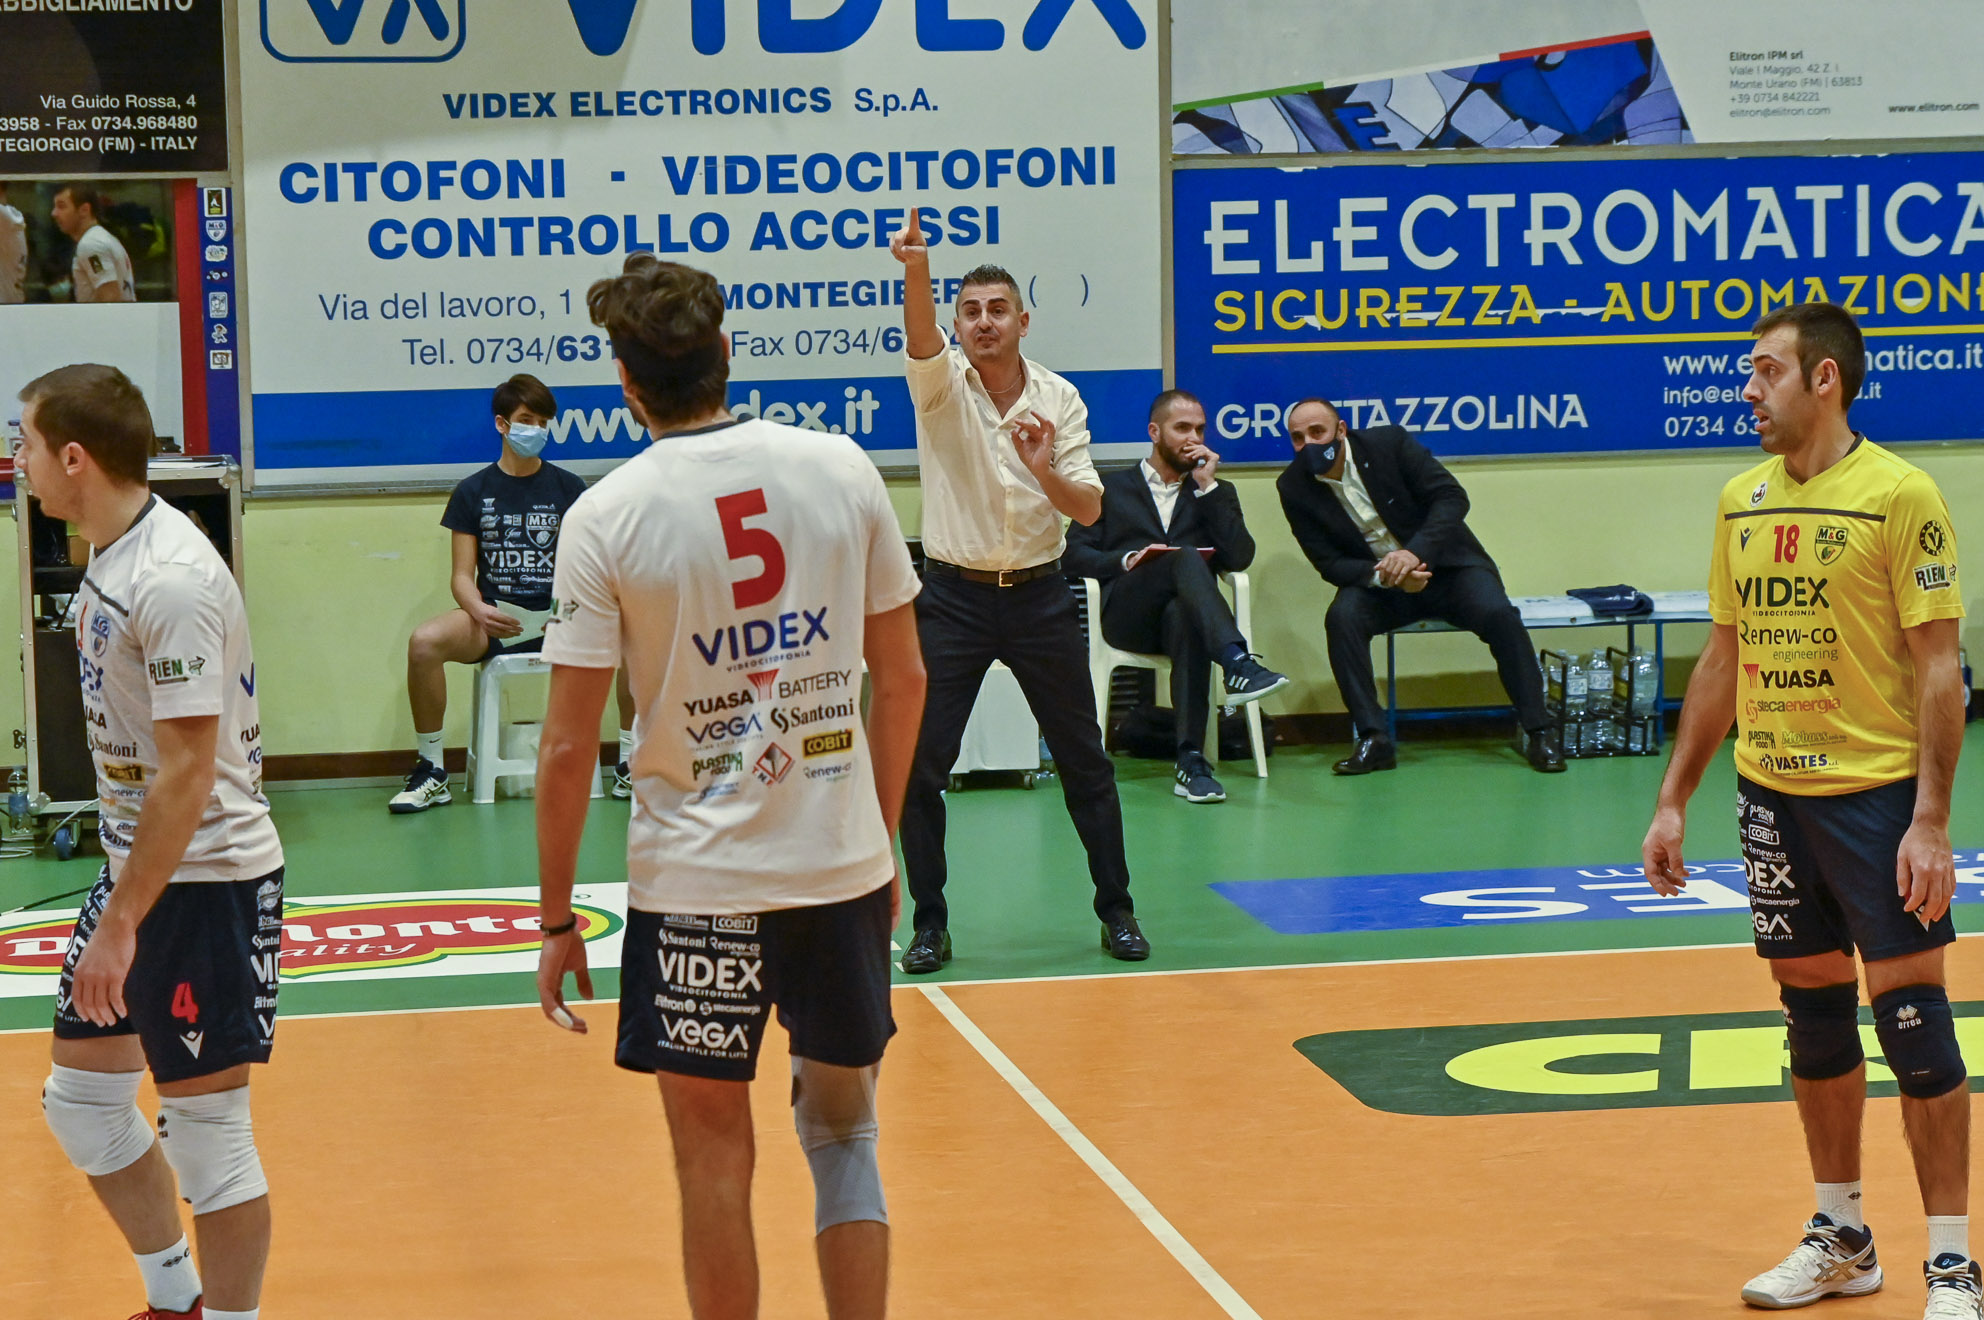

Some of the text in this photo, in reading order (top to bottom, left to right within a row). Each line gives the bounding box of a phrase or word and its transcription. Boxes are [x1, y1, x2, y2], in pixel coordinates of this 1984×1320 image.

[1729, 50, 1804, 61] Elitron IPM srl
[1729, 66, 1754, 75] Viale
[1807, 64, 1820, 73] 42
[1730, 80, 1763, 89] Monte
[1766, 79, 1798, 88] Urano
[1831, 76, 1863, 88] 63813
[40, 93, 197, 109] Via Guido Rossa, 4
[442, 87, 939, 120] VIDEX ELECTRONICS S.p.A.
[1753, 92, 1779, 103] 0734
[1782, 92, 1820, 102] 842221
[1888, 102, 1980, 113] www.elitron.com
[56, 116, 86, 131] Fax
[91, 115, 198, 130] 0734.968480
[1729, 107, 1831, 118] elitron@elitron.com
[98, 136, 135, 154] (FM)
[151, 136, 198, 150] ITALY
[279, 158, 566, 204] CITOFONI
[662, 146, 1116, 196] VIDEOCITOFONI
[368, 205, 1000, 260] CONTROLLO ACCESSI
[1204, 181, 1984, 275] ELECTROMATICA
[318, 293, 370, 321] Via
[380, 291, 428, 319] del
[440, 291, 546, 321] lavoro,
[559, 288, 572, 315] 1
[1214, 284, 1542, 332] SICUREZZA
[402, 337, 454, 365] Tel.
[731, 330, 784, 357] Fax
[1665, 415, 1725, 437] 0734
[714, 487, 787, 611] 5
[1774, 523, 1800, 564] 18
[484, 550, 555, 568] VIDEX
[1735, 577, 1830, 608] VIDEX
[692, 606, 830, 666] VIDEX
[1773, 648, 1839, 663] engineering
[778, 669, 852, 699] BATTERY
[1760, 669, 1835, 688] YUASA
[683, 689, 754, 717] YUASA
[790, 697, 855, 729] Santoni
[806, 731, 850, 753] COBIT
[1775, 753, 1828, 771] VASTES
[1751, 827, 1775, 842] COBIT
[1747, 842, 1787, 859] Renew-co
[1743, 855, 1796, 889] DEX
[717, 917, 753, 929] COBIT
[280, 942, 417, 957] ality
[657, 948, 763, 993] VIDEX
[171, 981, 200, 1024] 4
